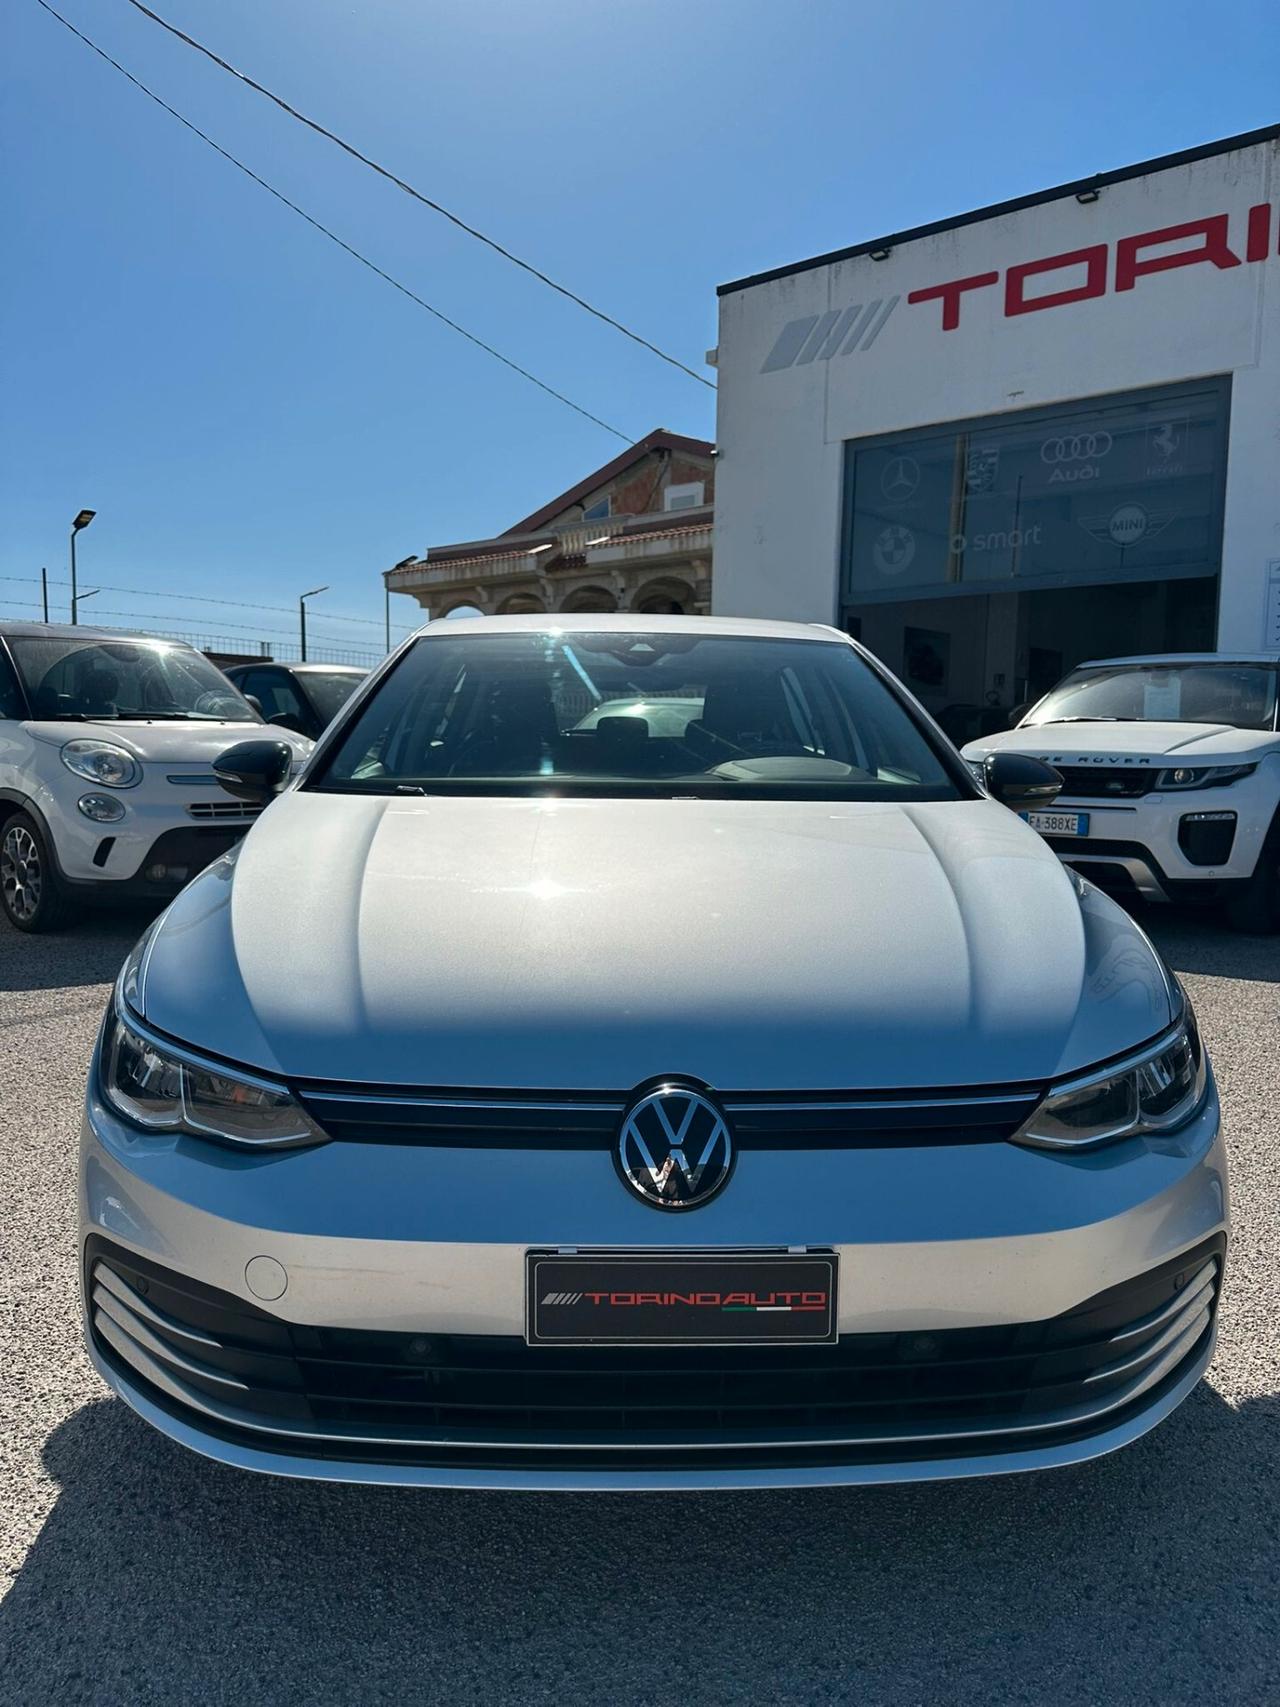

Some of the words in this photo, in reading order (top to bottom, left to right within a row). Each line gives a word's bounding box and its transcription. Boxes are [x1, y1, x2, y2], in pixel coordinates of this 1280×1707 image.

[907, 203, 1280, 332] TORI
[1047, 464, 1100, 484] Audi
[1112, 518, 1144, 531] MINI
[972, 525, 1041, 551] smart
[1077, 756, 1151, 765] ROVER
